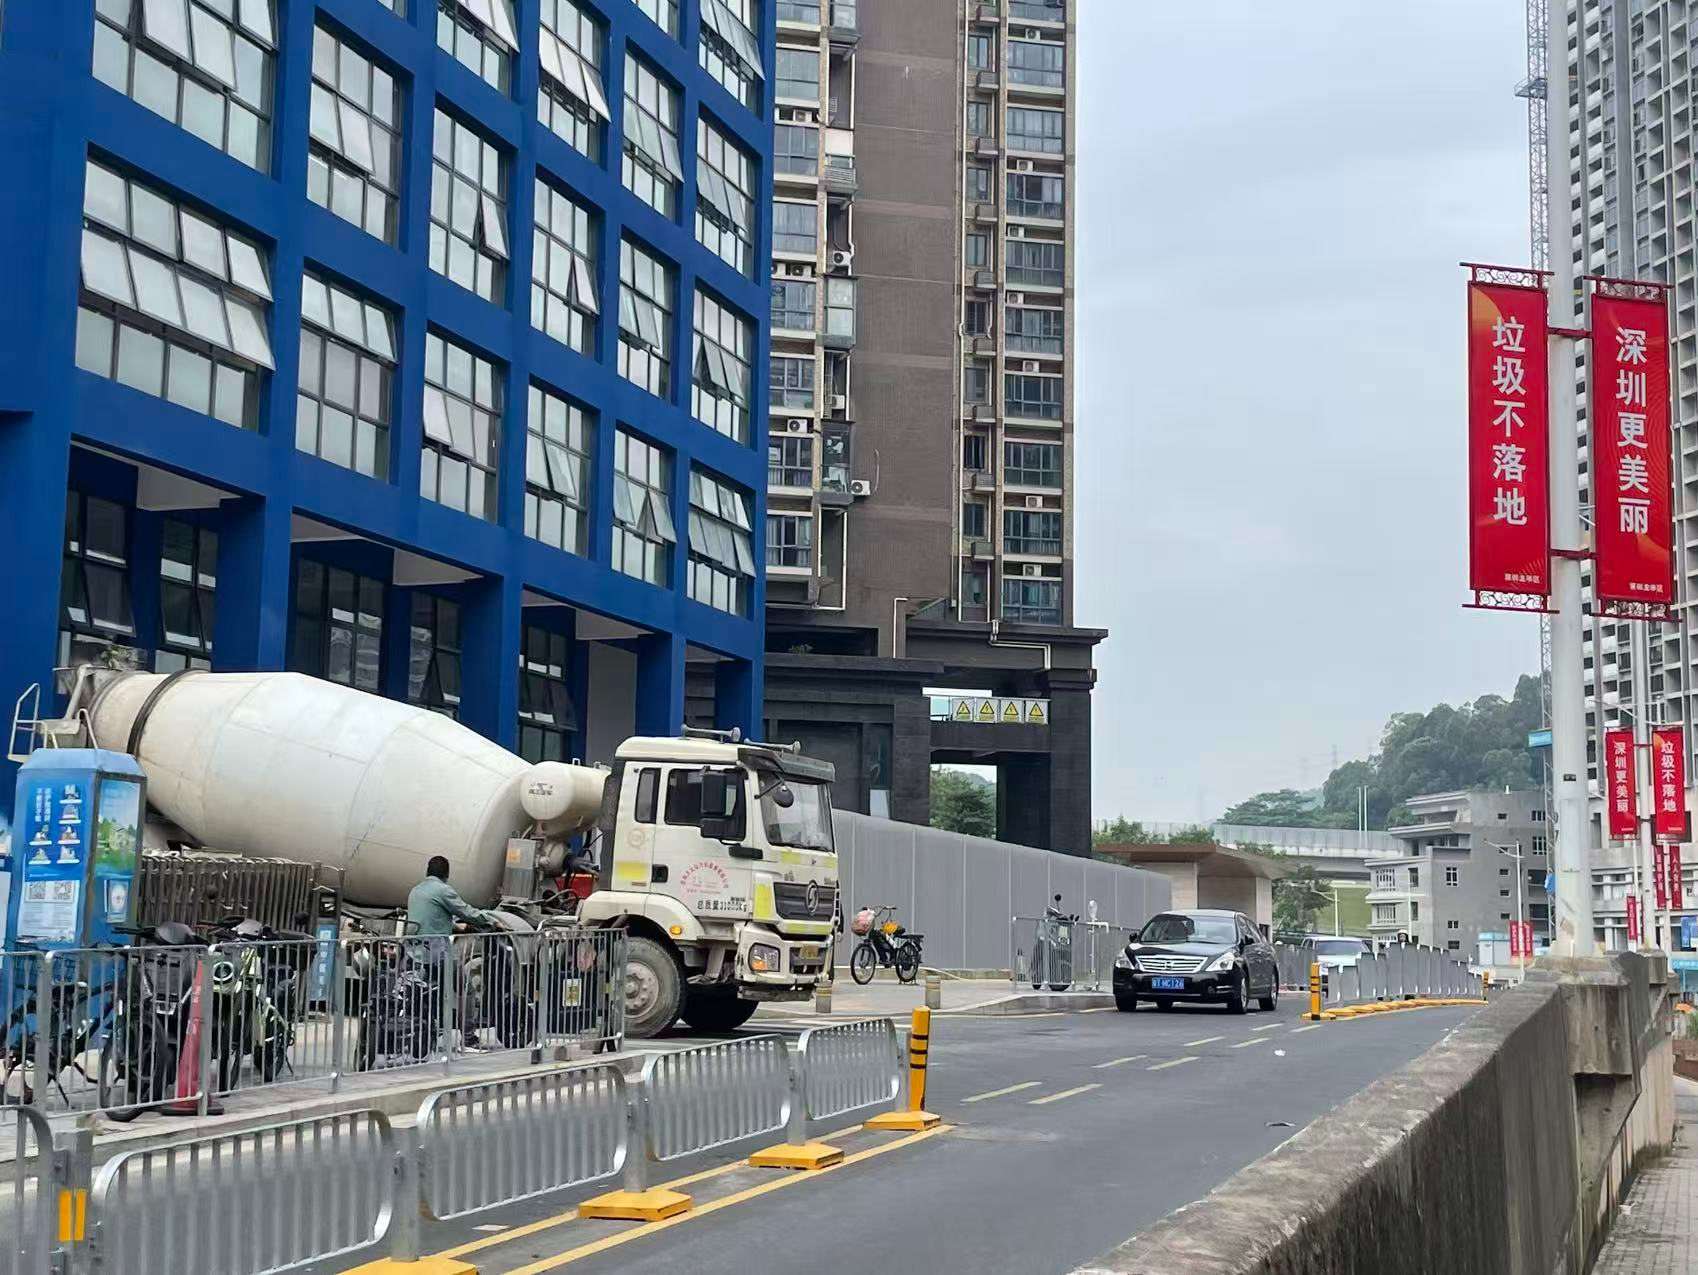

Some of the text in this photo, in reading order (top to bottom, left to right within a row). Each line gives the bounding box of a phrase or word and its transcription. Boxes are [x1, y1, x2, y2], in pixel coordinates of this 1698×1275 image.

[1492, 315, 1528, 526] 垃圾不落地
[1615, 326, 1650, 535] 深圳更美丽
[1614, 741, 1629, 812] 深圳更美丽
[1661, 741, 1677, 812] 垃圾不落地
